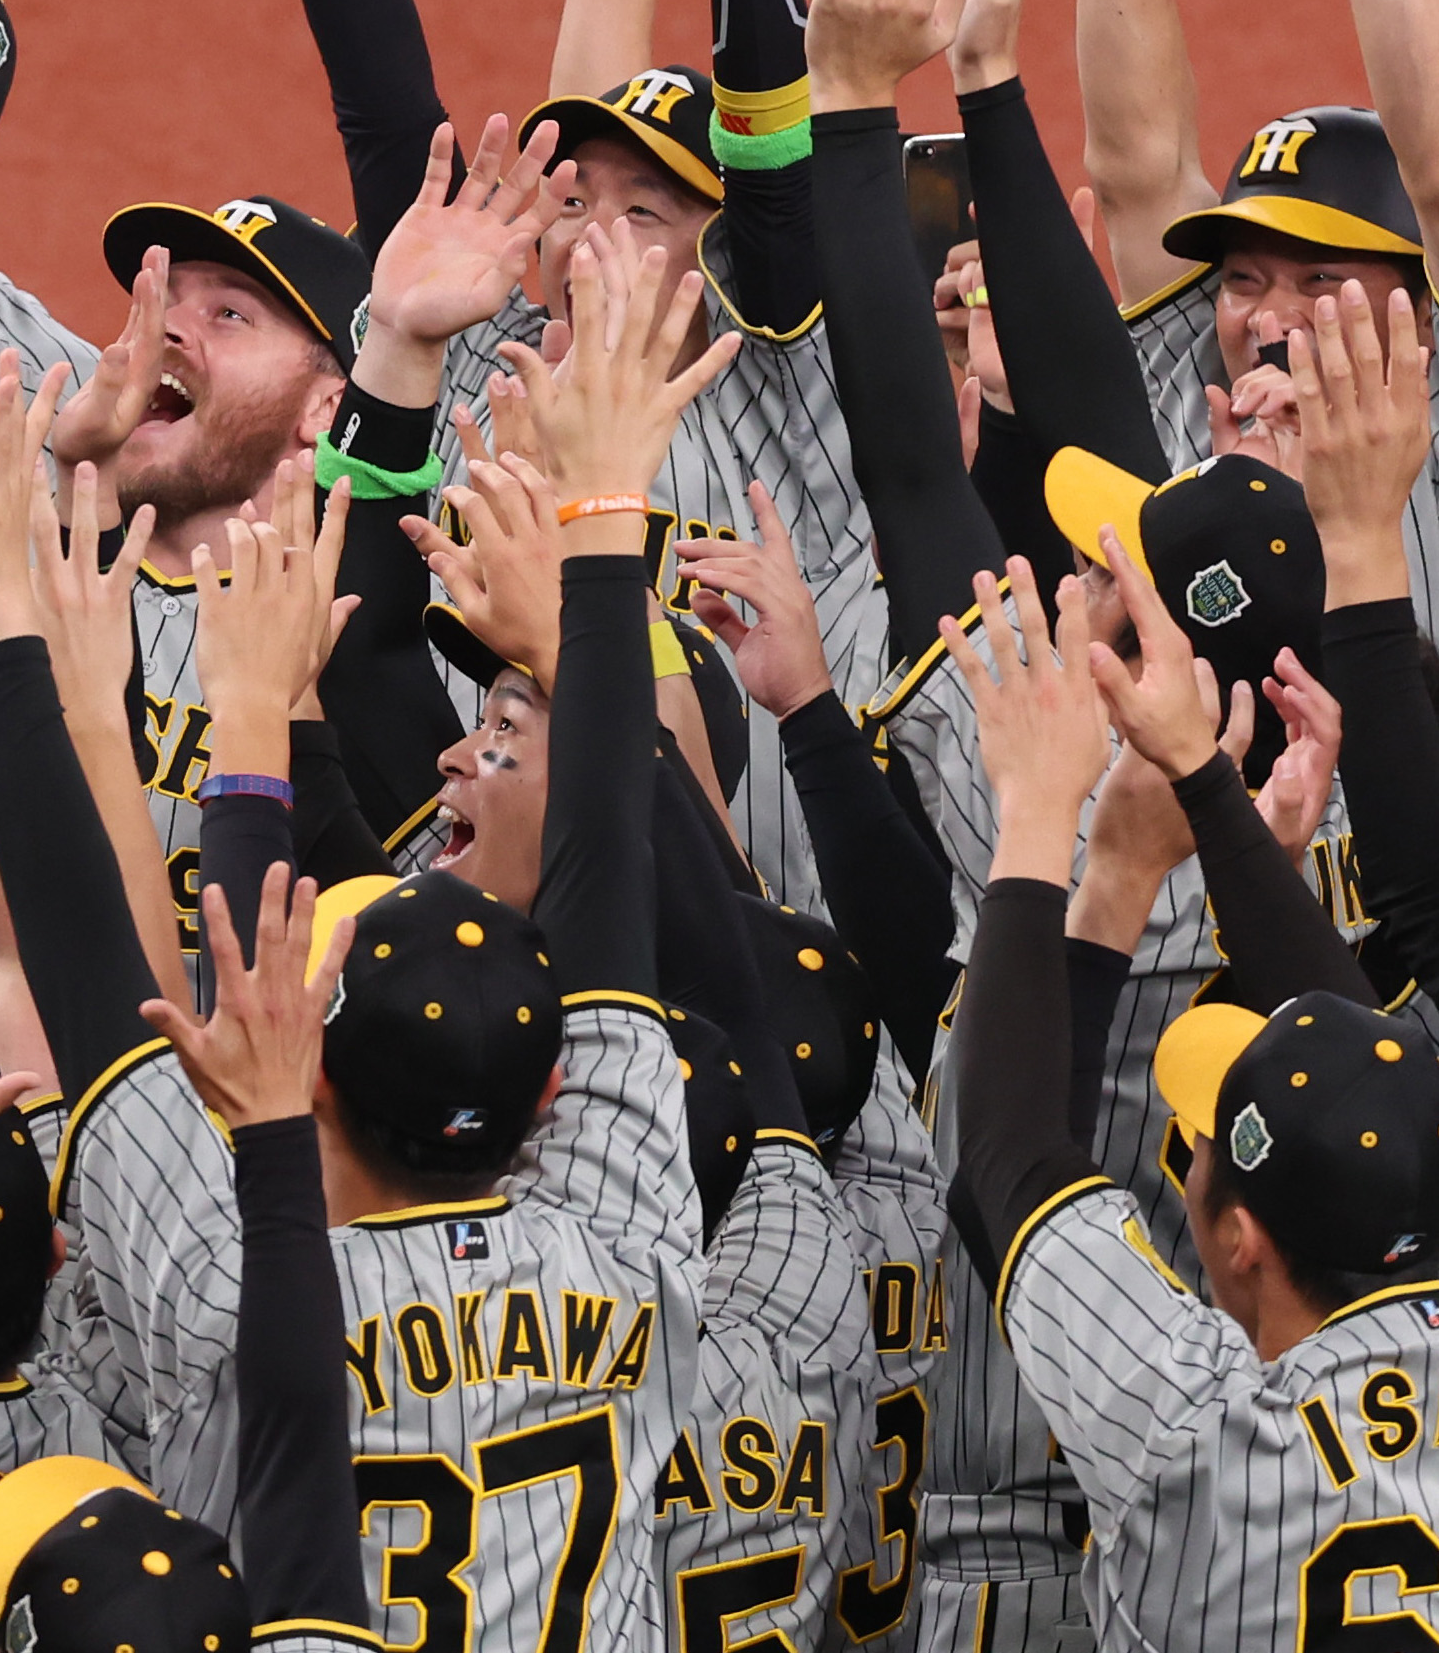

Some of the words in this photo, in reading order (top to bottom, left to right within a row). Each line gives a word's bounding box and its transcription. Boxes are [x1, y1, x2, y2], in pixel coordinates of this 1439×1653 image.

[345, 1288, 657, 1416] YOKAWA
[1297, 1367, 1439, 1491] IS
[352, 1402, 623, 1653] 37
